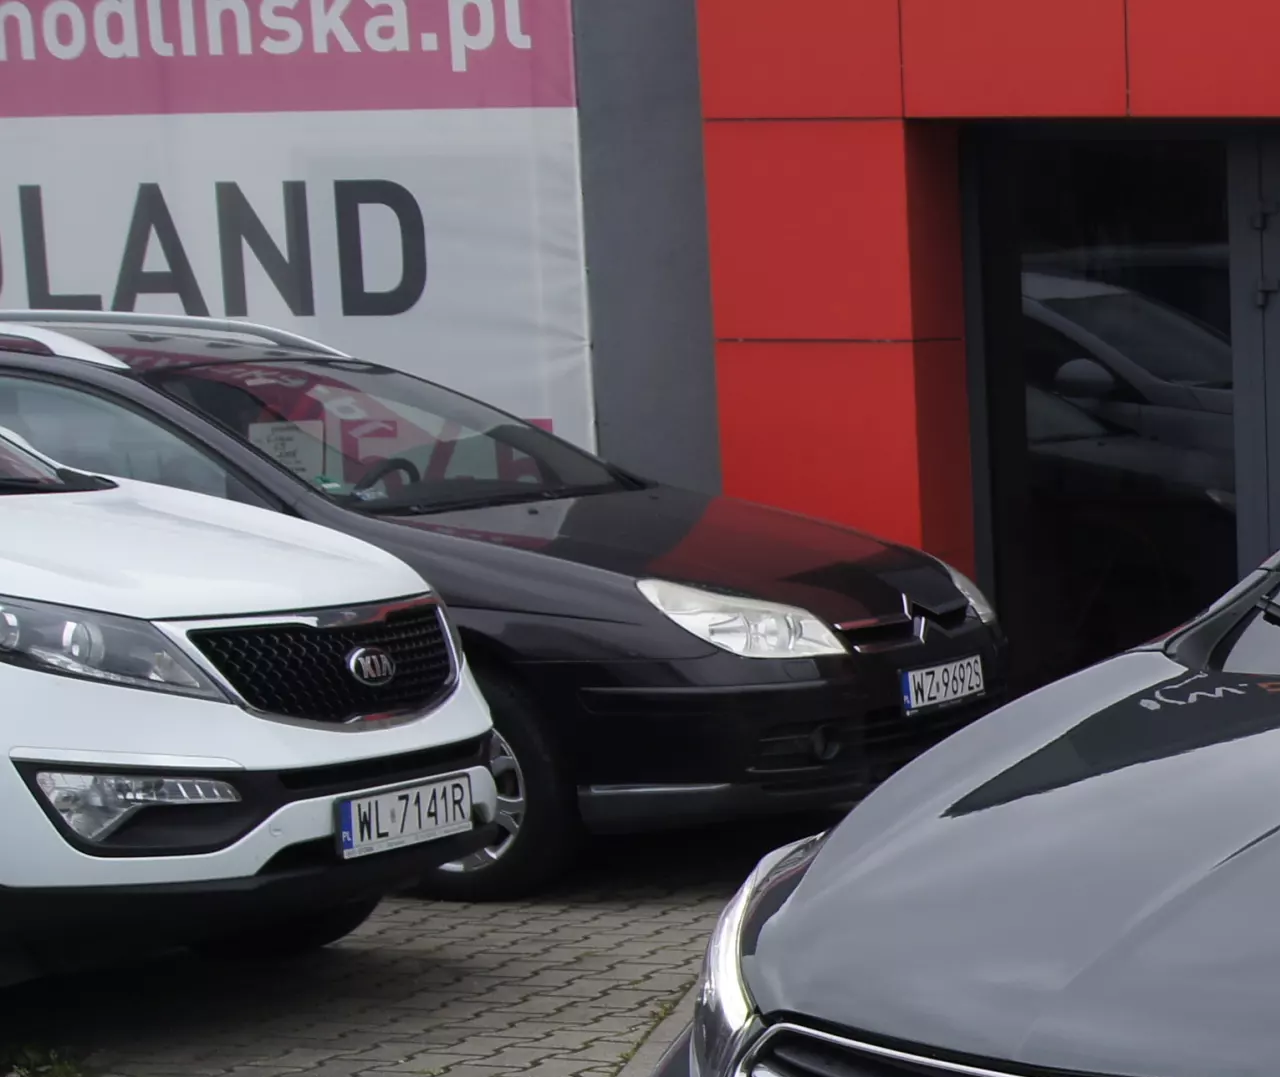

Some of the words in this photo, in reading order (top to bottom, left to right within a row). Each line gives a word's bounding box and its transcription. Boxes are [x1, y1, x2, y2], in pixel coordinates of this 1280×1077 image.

[0, 179, 427, 317] LAND
[357, 654, 394, 679] KIA
[912, 670, 937, 705] WZ
[941, 658, 982, 698] 9692S
[357, 799, 389, 842] WL
[398, 783, 466, 834] 7141R
